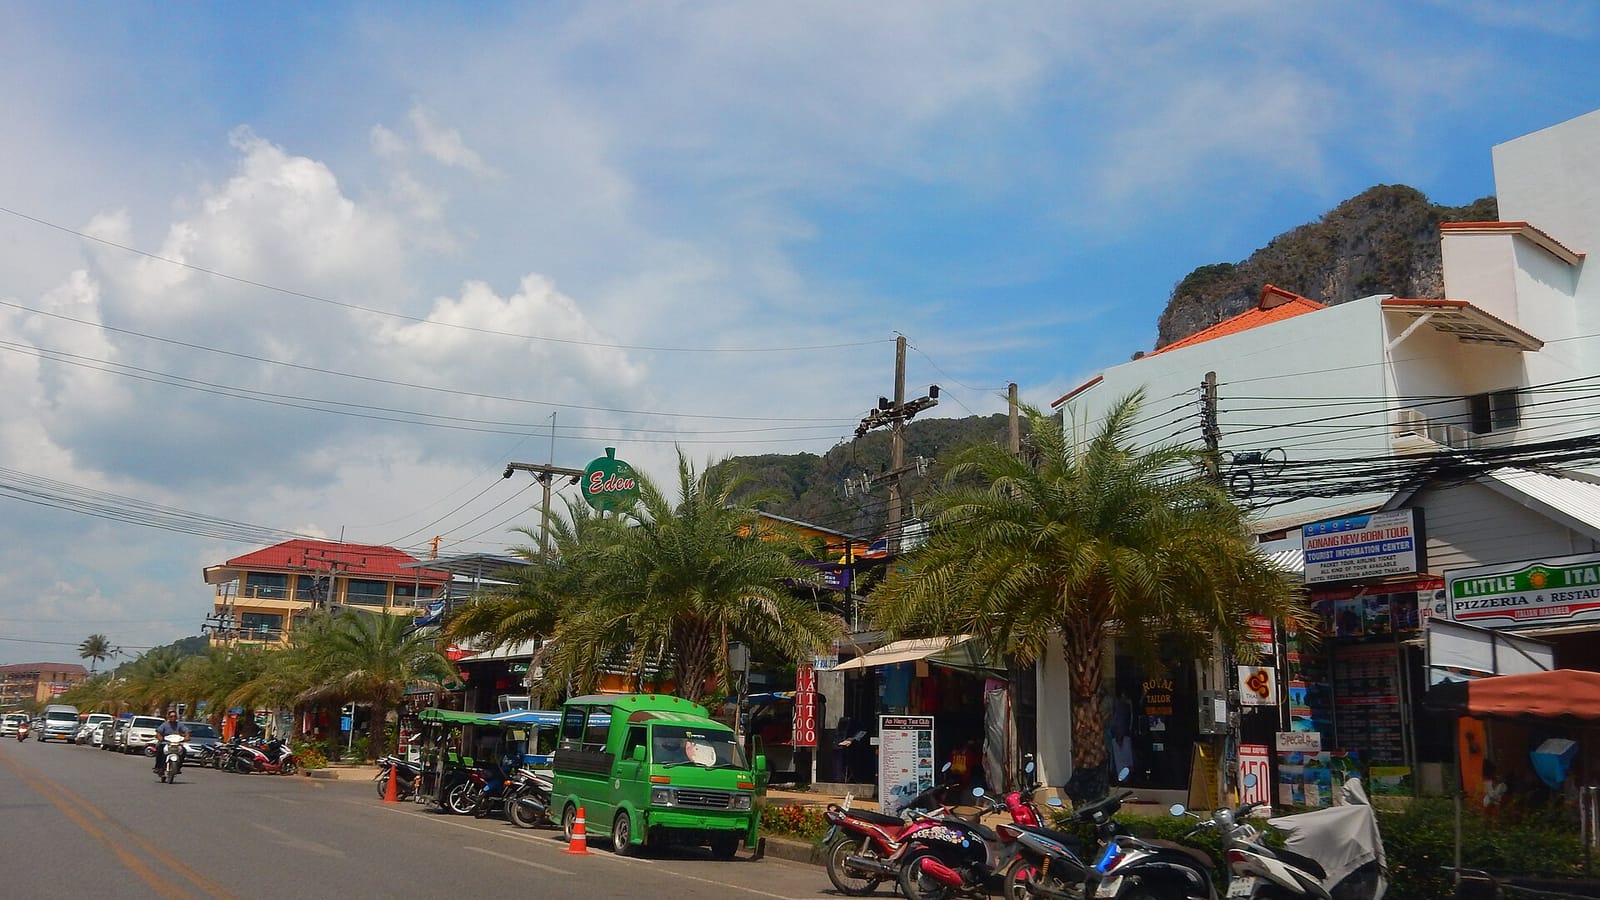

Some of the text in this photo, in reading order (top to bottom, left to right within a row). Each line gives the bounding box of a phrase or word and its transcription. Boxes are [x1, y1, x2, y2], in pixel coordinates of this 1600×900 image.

[589, 471, 635, 494] Eden
[1307, 526, 1409, 549] AONANG NEW BORN TOUR
[1307, 541, 1410, 560] TOURIST INFORMATION CENTER
[1463, 576, 1516, 595] LITTLE
[1564, 566, 1600, 585] ITA
[1455, 595, 1528, 611] PIZZERIA
[1536, 595, 1544, 603] &
[1142, 679, 1174, 692] ROYAL
[805, 667, 816, 743] TATTOO
[1146, 694, 1171, 704] TAILOR
